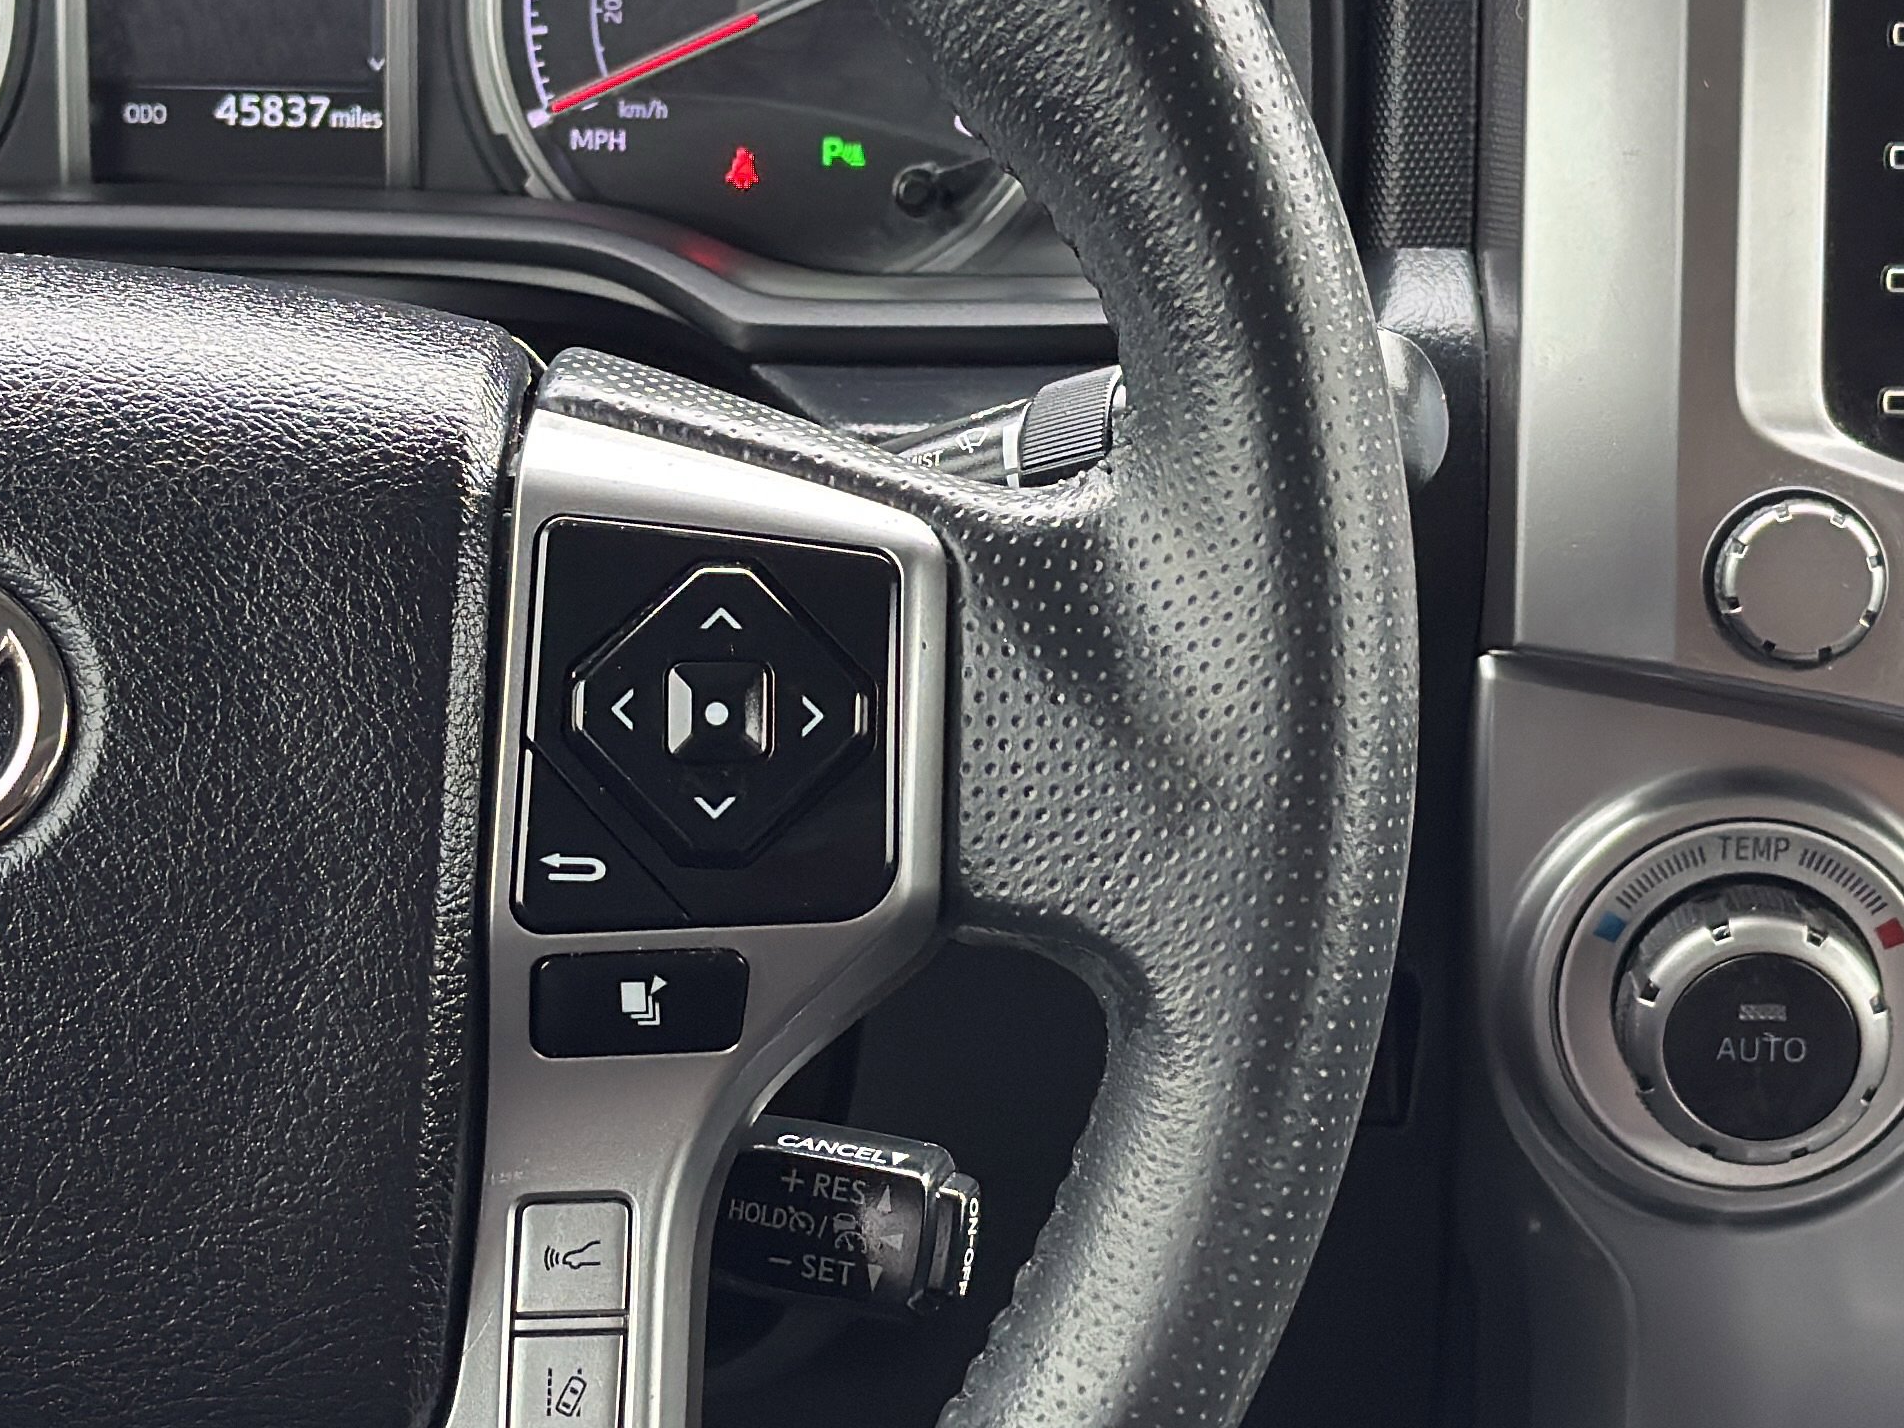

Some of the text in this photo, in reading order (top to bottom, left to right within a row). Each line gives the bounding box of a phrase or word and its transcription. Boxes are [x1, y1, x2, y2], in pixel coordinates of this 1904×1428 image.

[122, 93, 384, 130] ODO 45837 miles
[617, 98, 669, 122] km/h
[569, 128, 627, 153] MPH
[1718, 834, 1792, 864] TEMP
[1715, 1035, 1808, 1064] AUTO
[776, 1133, 888, 1165] CANCEL
[812, 1172, 867, 1206] RES
[727, 1198, 789, 1230] HOLD
[800, 1253, 856, 1287] SET
